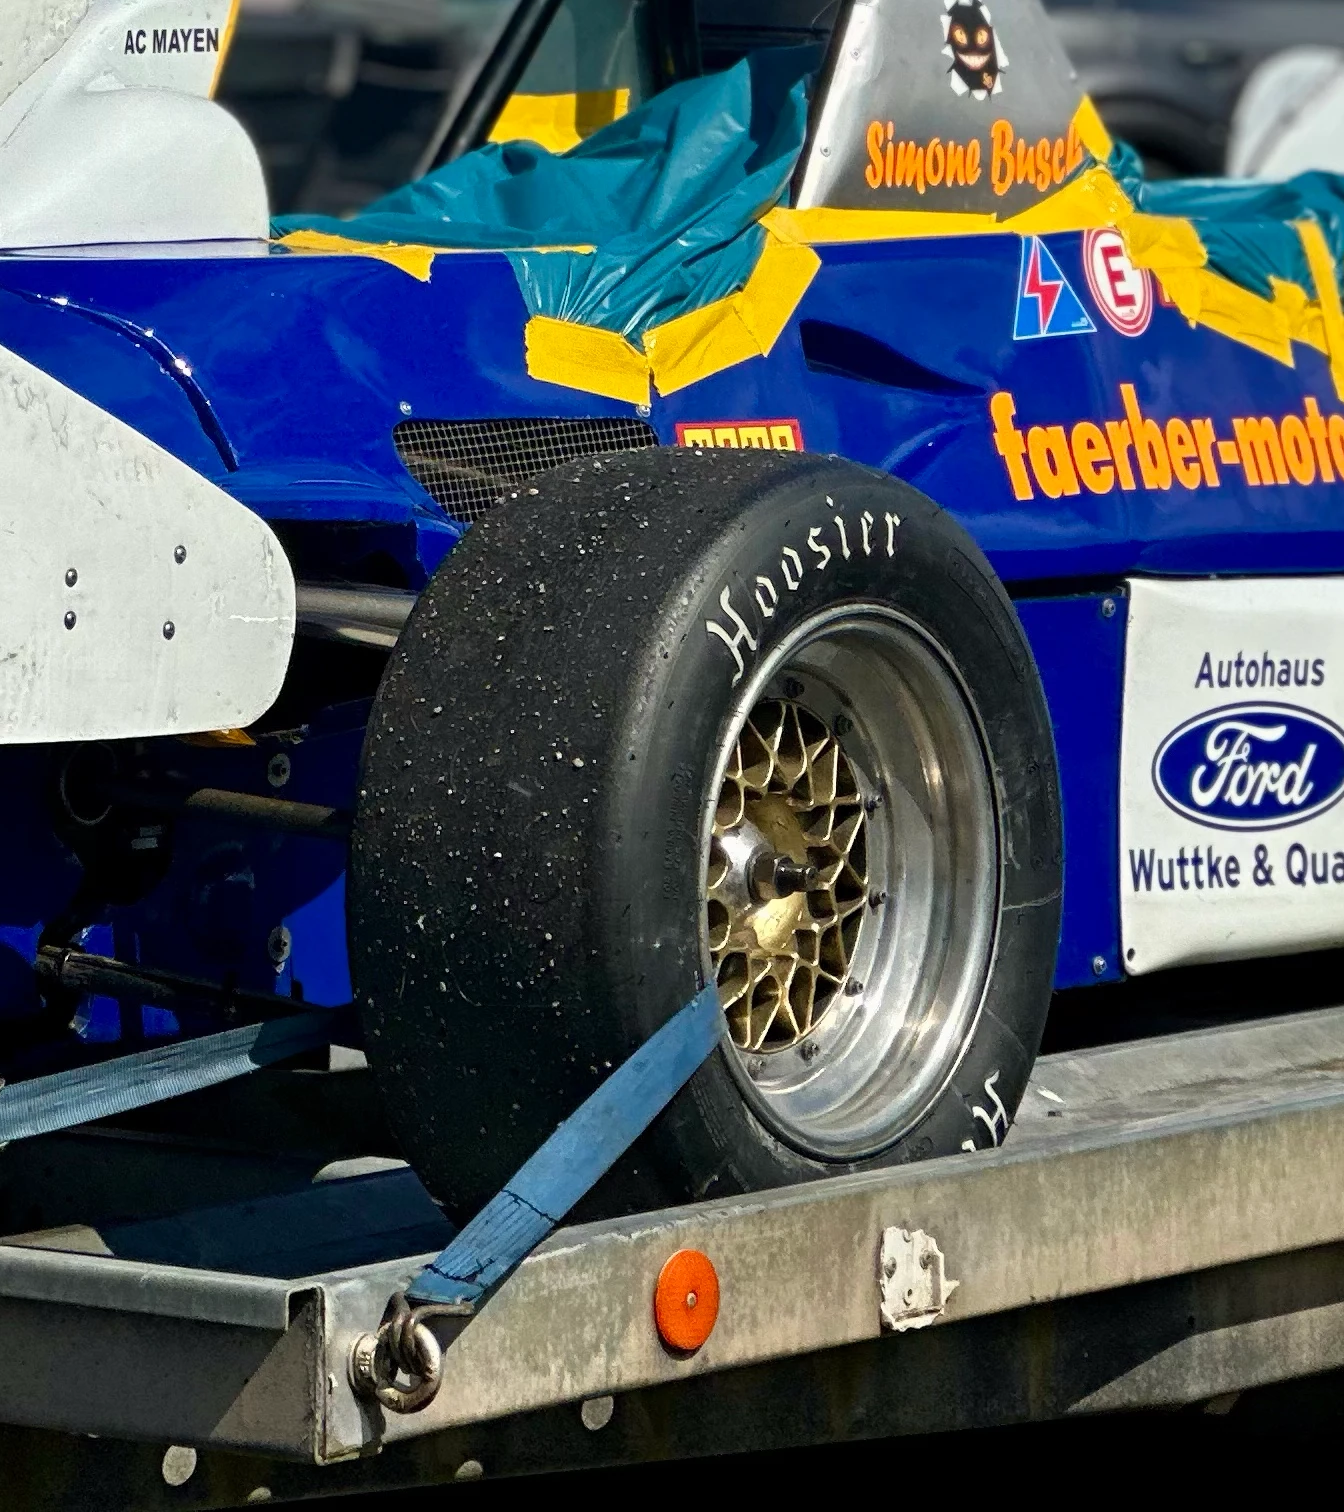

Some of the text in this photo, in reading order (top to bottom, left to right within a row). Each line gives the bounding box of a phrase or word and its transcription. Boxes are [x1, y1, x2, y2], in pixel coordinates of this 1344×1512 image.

[124, 28, 219, 55] AC MAYEN
[864, 120, 982, 195] Simone
[1100, 245, 1136, 308] E
[706, 494, 901, 688] Hoosier
[1194, 650, 1325, 689] Autohaus
[1190, 721, 1318, 807] Ford
[1129, 845, 1240, 892] Wuttke
[1252, 843, 1275, 887] &
